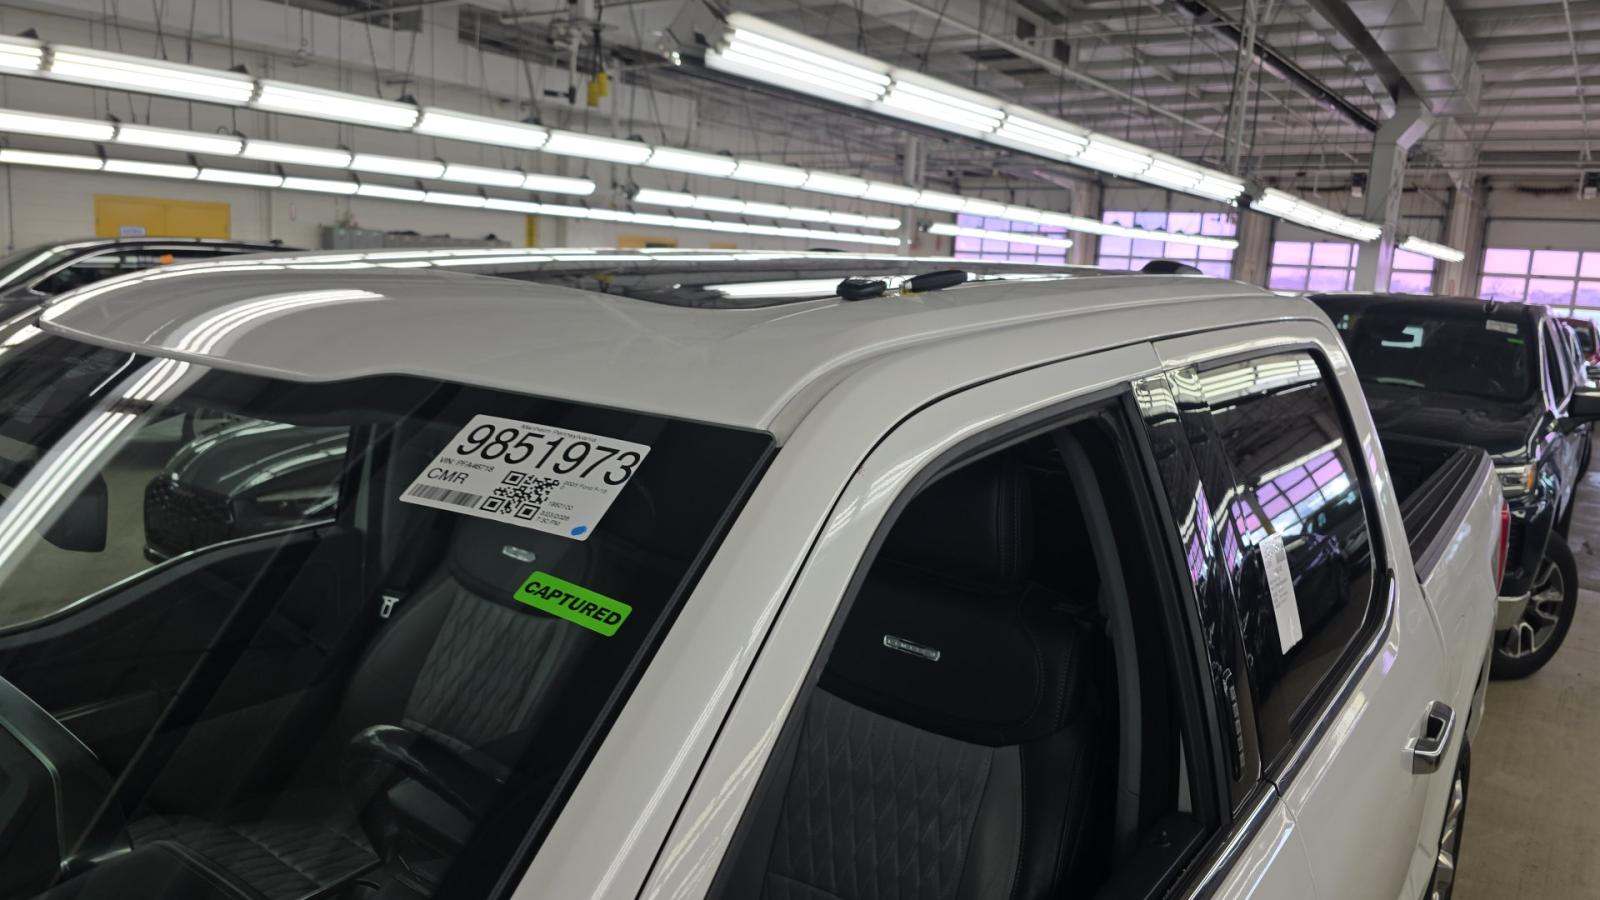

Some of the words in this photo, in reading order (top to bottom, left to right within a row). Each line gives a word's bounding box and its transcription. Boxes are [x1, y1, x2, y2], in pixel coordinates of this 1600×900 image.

[427, 467, 470, 486] CMR
[456, 424, 641, 487] 9851973
[524, 581, 622, 627] CAPTURED
